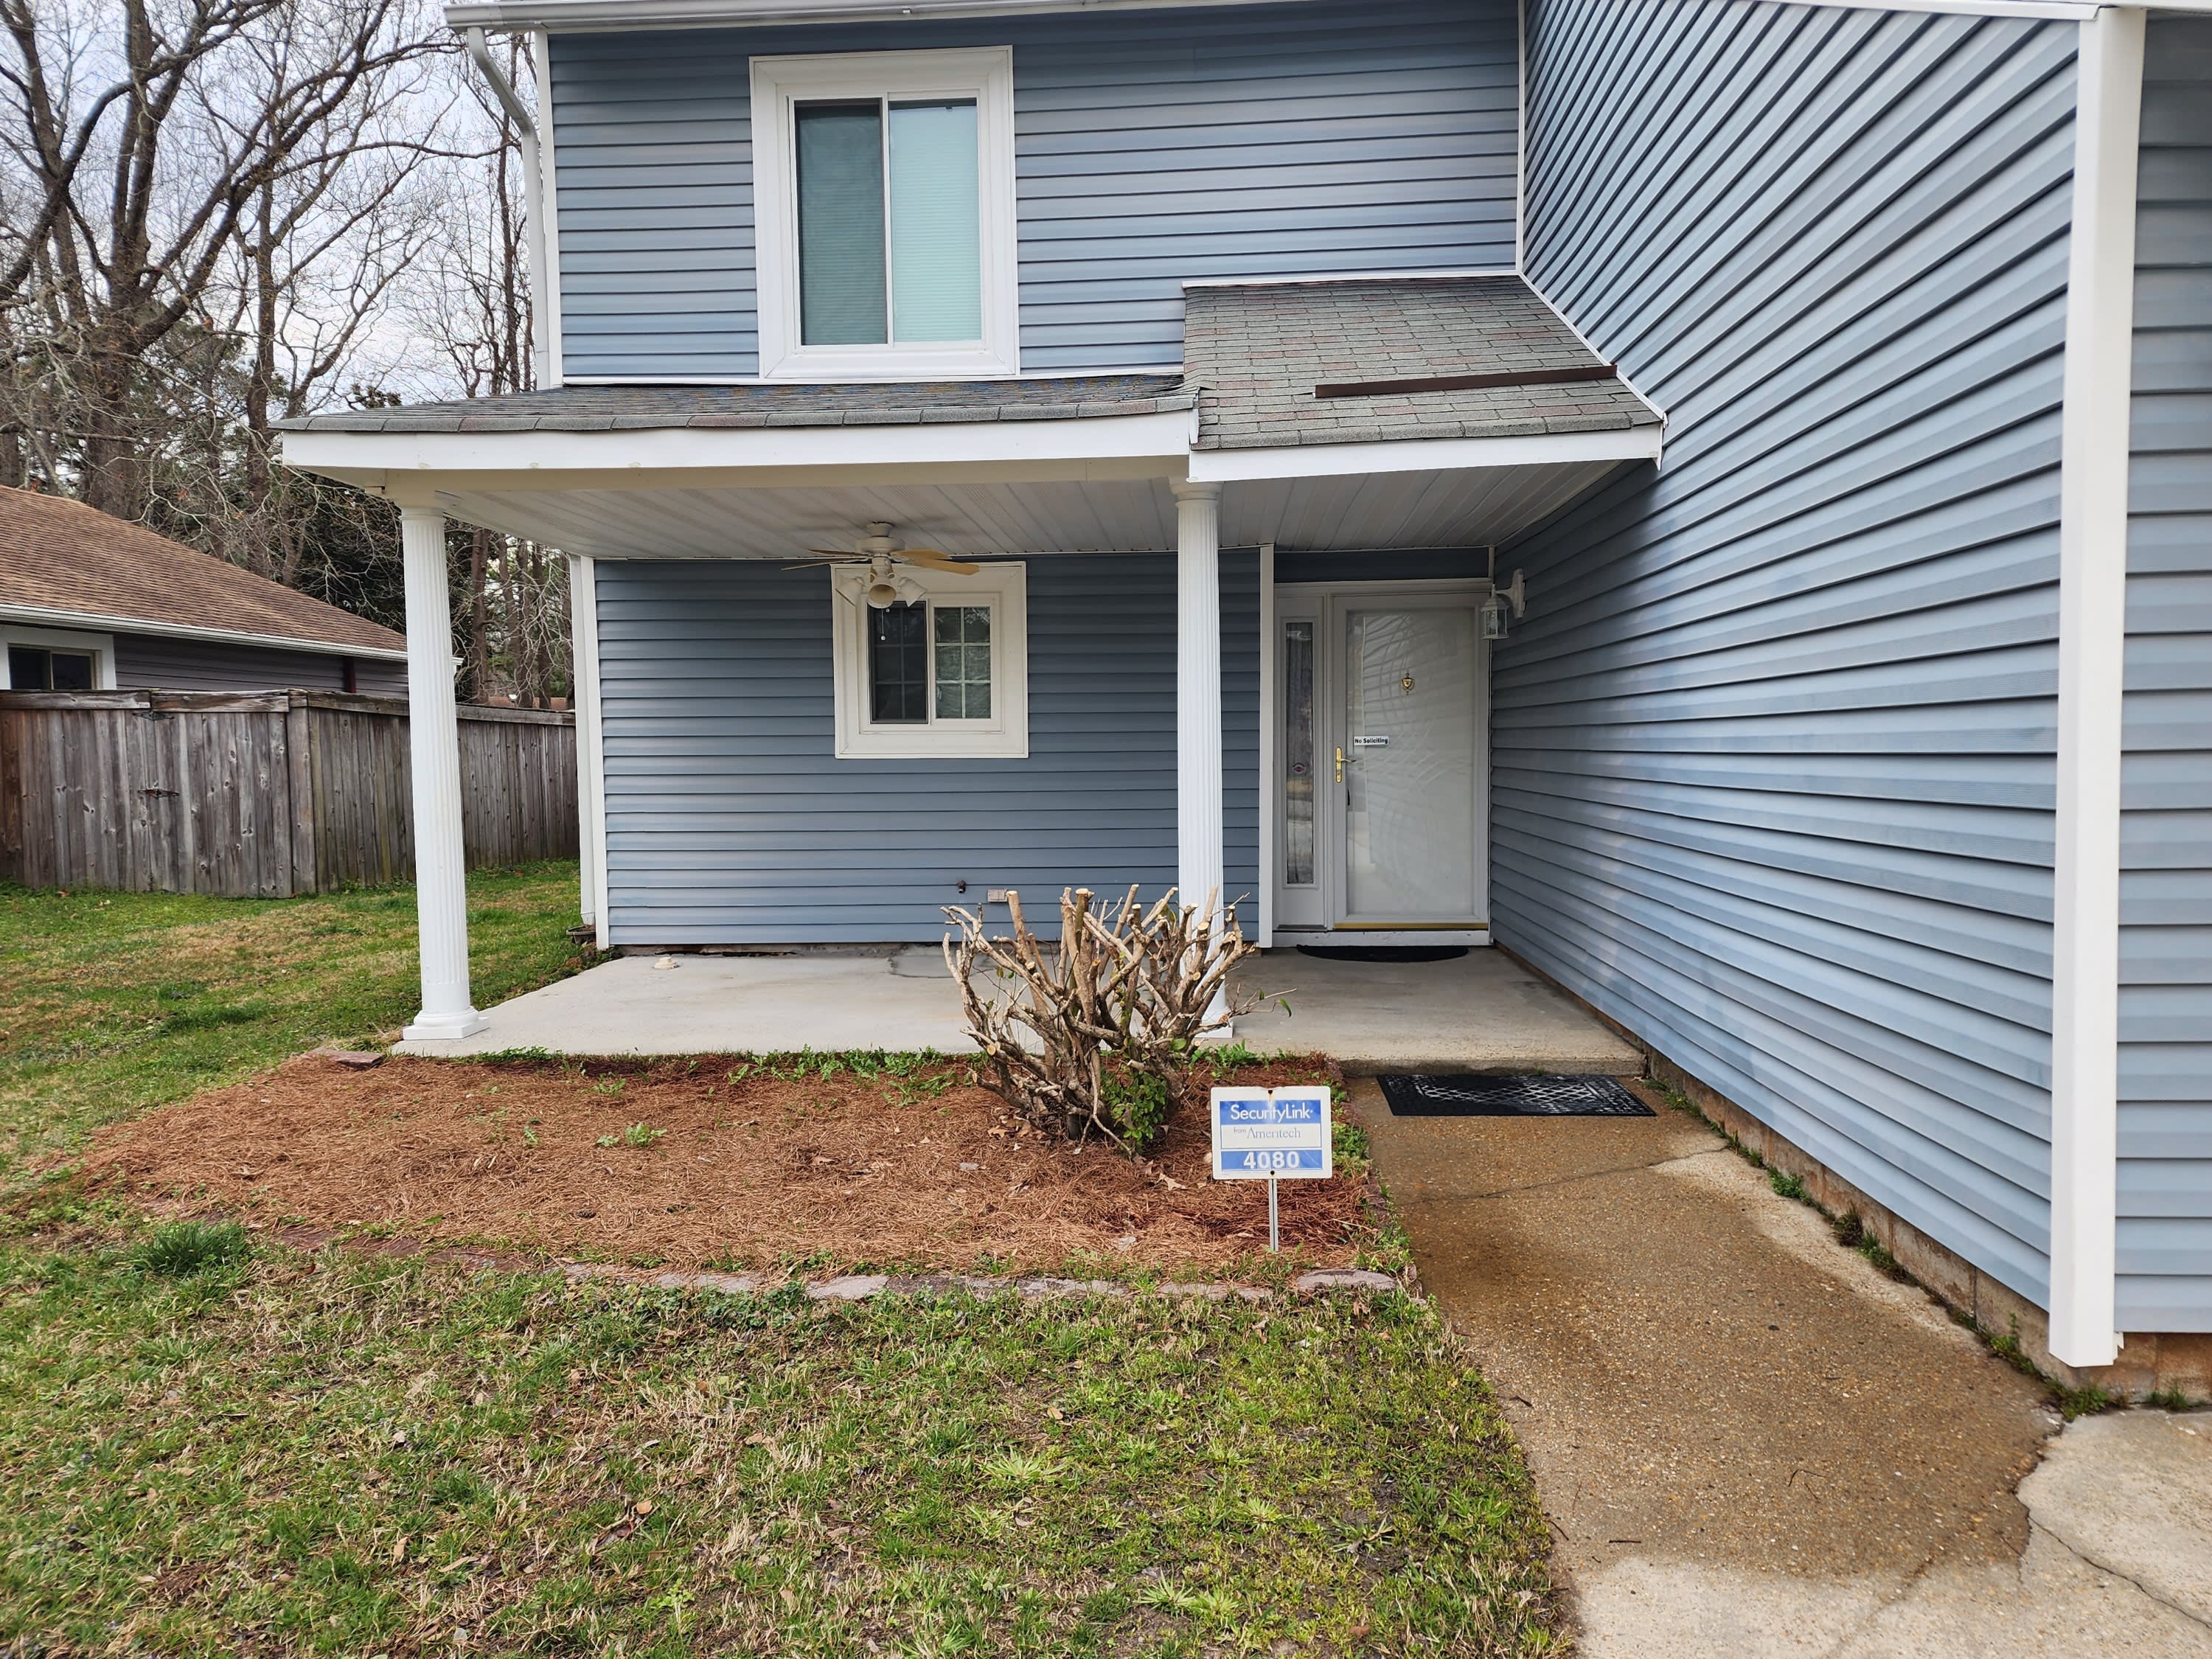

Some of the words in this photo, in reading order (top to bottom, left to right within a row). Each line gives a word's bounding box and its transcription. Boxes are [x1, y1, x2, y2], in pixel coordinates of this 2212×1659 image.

[1230, 1102, 1311, 1123] SecurityLink
[1247, 1127, 1301, 1139] Ameritech
[1243, 1150, 1300, 1169] 4080
